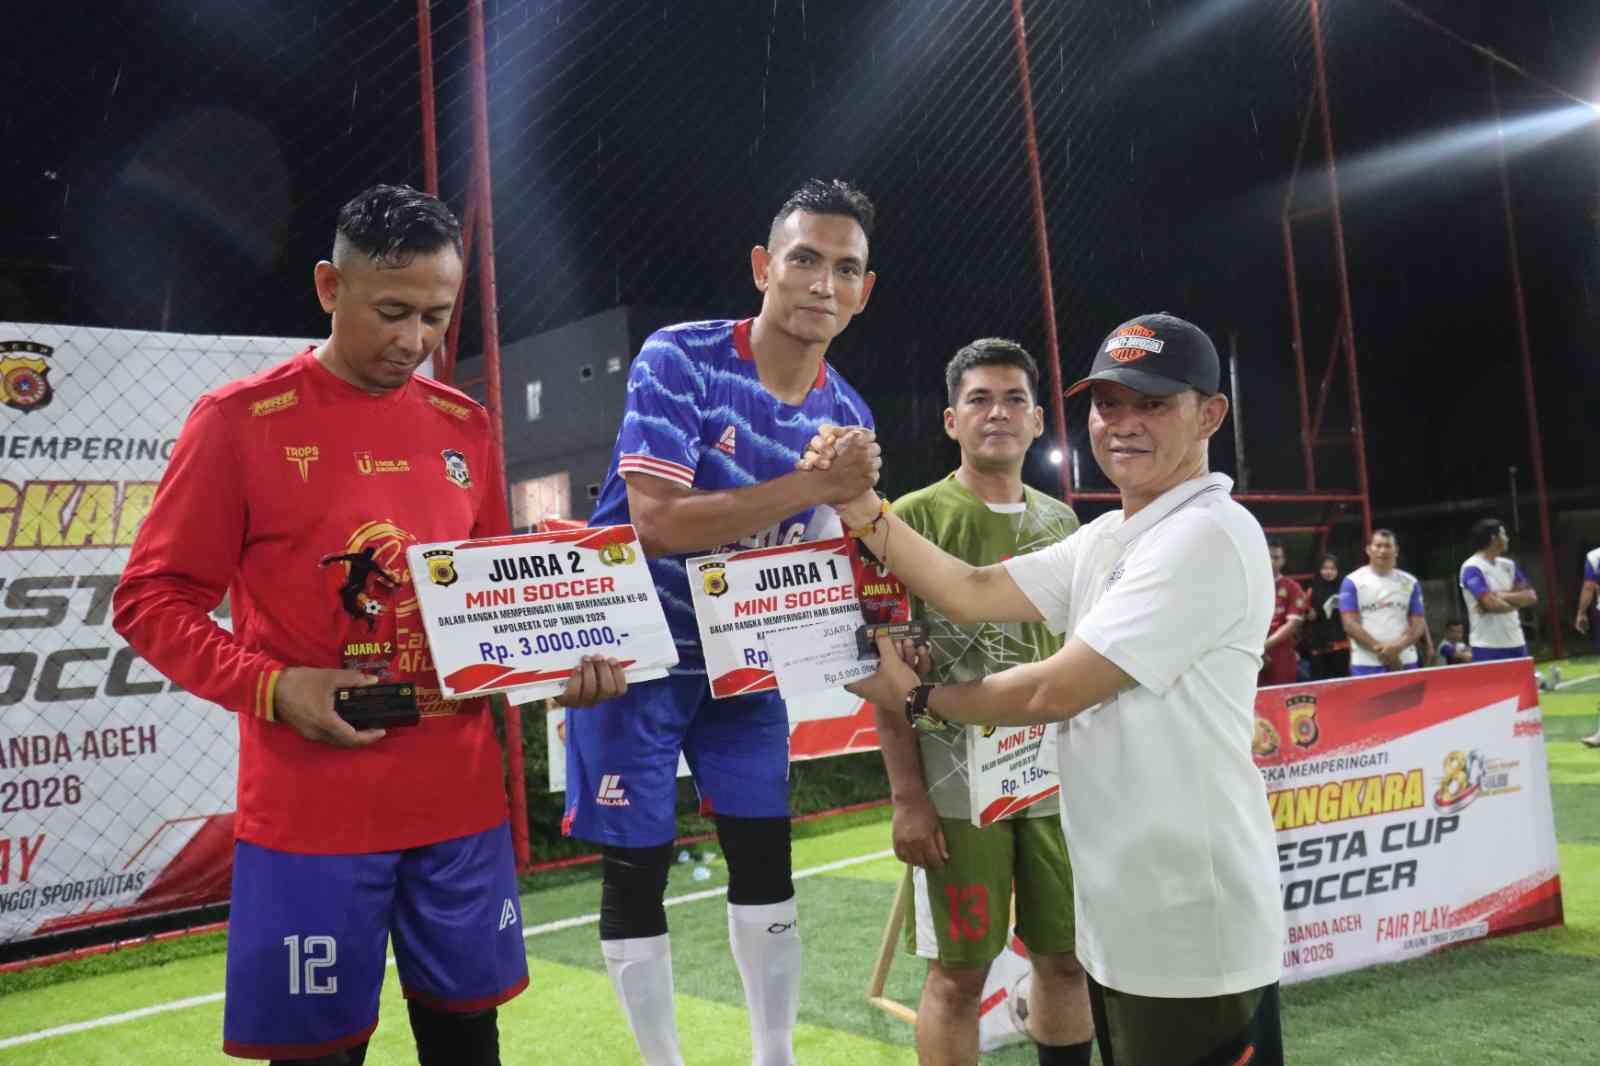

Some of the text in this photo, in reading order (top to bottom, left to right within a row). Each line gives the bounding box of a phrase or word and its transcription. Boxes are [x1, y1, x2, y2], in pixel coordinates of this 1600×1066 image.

[0, 435, 178, 461] EMPERIN
[488, 551, 585, 582] JUARA 2
[755, 559, 840, 592] JUARA 1
[466, 577, 615, 609] MINI SOCCER
[734, 596, 778, 618] MINI
[784, 584, 860, 609] SOCCE
[438, 616, 466, 627] DALAM
[467, 612, 498, 624] RANGKA
[500, 604, 556, 620] MEMPERINGATI
[558, 602, 574, 613] HARI
[575, 596, 627, 611] BHAYANGKARA
[492, 612, 606, 634] KAPOLRESTA CUP TAHUN 2026
[709, 623, 733, 634] DALAM
[734, 619, 761, 630] RANGKA
[762, 611, 812, 627] MEMPERINGATI
[814, 608, 829, 619] HARI
[830, 604, 861, 617] BHAYANG
[344, 641, 392, 656] JUARA 2
[479, 626, 630, 665] Rp. 3.000.000,-
[82, 724, 157, 762] ACEH
[997, 729, 1025, 753] MINI
[1022, 766, 1049, 785] 1.50
[1289, 752, 1389, 779] MEMPERINGATI
[1, 774, 82, 813] 2026
[1379, 815, 1460, 854] CUP
[40, 871, 147, 907] SPORTIVITAS
[944, 884, 990, 943] 13
[1288, 919, 1329, 944] BANDA
[1331, 913, 1363, 935] ACEH
[1375, 913, 1409, 944] FAIR
[1412, 904, 1451, 935] PLAY
[283, 935, 338, 994] 12
[1303, 942, 1334, 964] 2026
